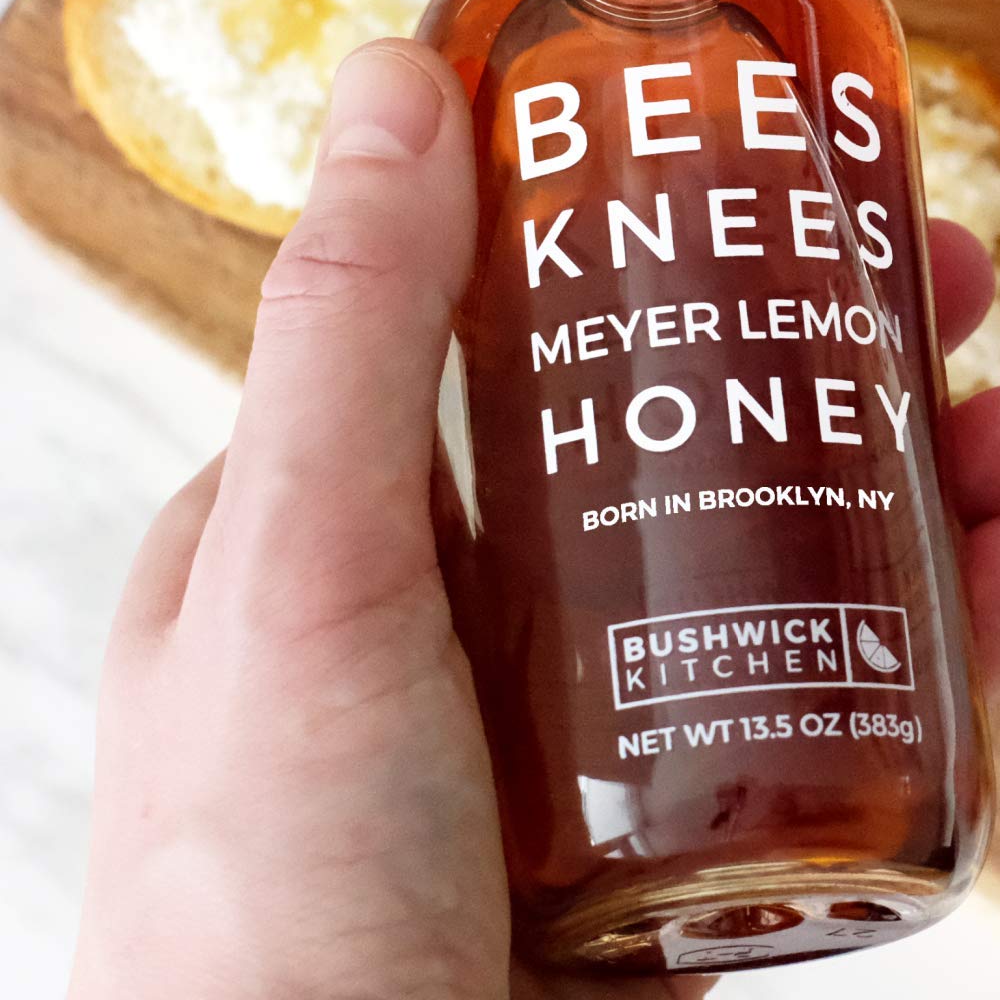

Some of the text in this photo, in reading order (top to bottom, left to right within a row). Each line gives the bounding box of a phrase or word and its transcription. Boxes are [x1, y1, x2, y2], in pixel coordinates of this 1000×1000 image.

[514, 60, 881, 181] BEES
[523, 188, 893, 289] KNEES
[531, 299, 903, 372] MEYER LEMON
[541, 376, 911, 475] HONEY
[582, 486, 895, 531] BORN IN BROOKLYN, NY
[623, 618, 833, 663] BUSHWICK
[626, 648, 838, 692] KITCHEN
[618, 712, 923, 760] NET WT 13.5 OZ (383g)
